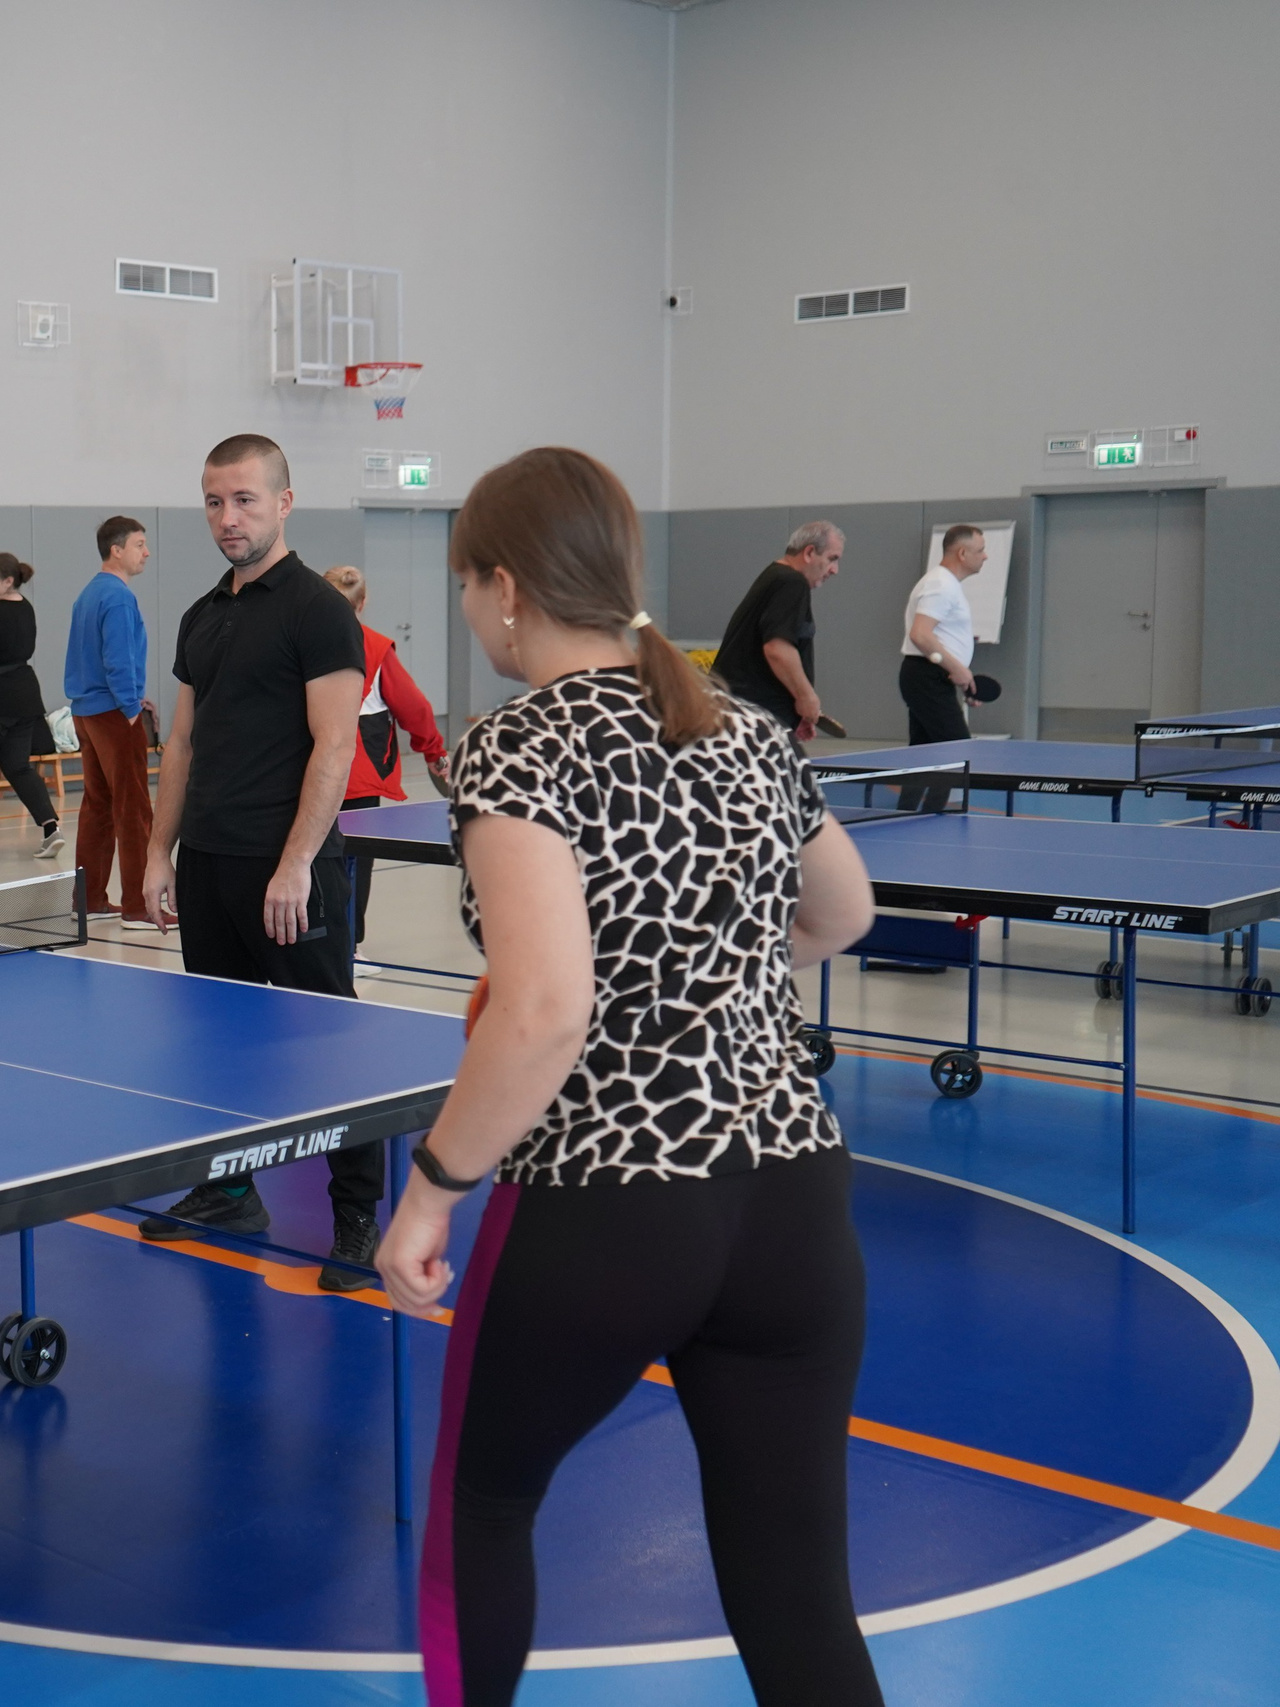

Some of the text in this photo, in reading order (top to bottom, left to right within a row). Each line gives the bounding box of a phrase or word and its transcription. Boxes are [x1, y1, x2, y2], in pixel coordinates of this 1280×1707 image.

[1019, 781, 1069, 793] GAME INDOOR
[1240, 791, 1265, 802] GAME
[1052, 906, 1129, 925] START
[208, 1138, 295, 1180] START
